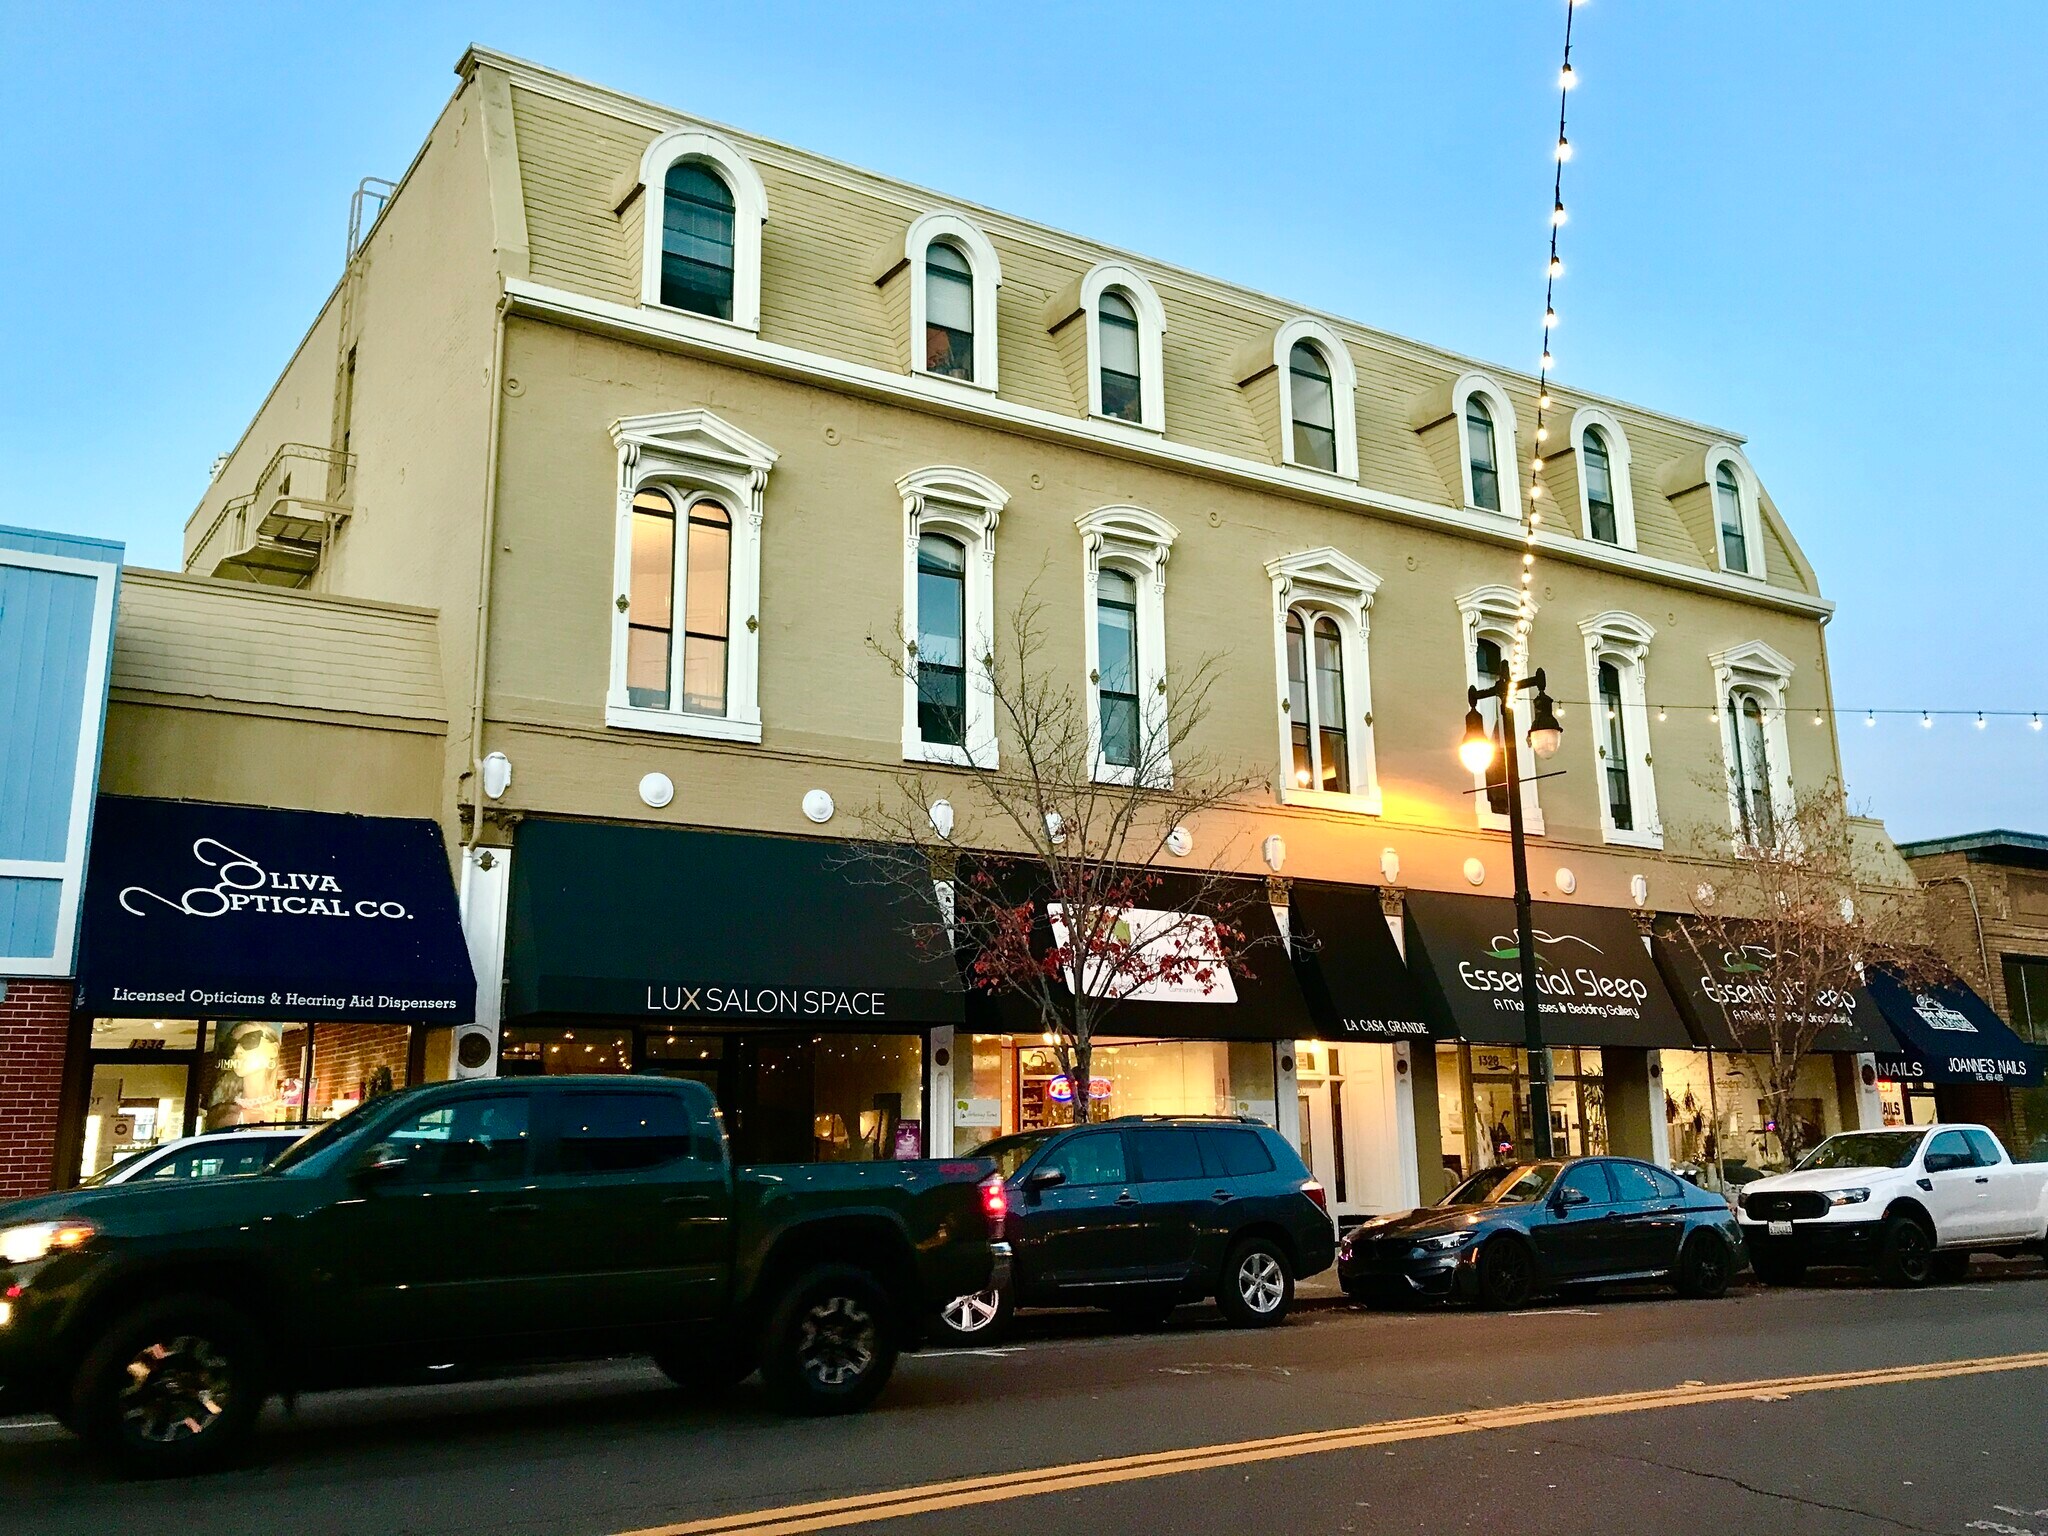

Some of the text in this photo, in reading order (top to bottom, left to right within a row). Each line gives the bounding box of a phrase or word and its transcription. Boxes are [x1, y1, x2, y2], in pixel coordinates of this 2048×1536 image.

[220, 861, 342, 893] OLIVA
[182, 887, 414, 920] OPTICAL CO.
[1575, 967, 1648, 1006] Sleep
[1794, 980, 1856, 1015] Seep
[112, 987, 457, 1012] Licensed Opticians & Hearing Aid Dispensers
[648, 986, 886, 1015] LUX SALON SPACE
[1493, 998, 1504, 1011] A
[1502, 999, 1558, 1014] Matsses
[1568, 1002, 1608, 1018] Bedding
[1606, 1005, 1640, 1019] Gallery
[1343, 1018, 1359, 1031] LA
[1360, 1019, 1386, 1032] CASA
[1387, 1020, 1429, 1034] GRANDE
[1478, 1055, 1500, 1066] 1328
[1877, 1061, 1923, 1077] NAILS
[1948, 1057, 2027, 1075] JOANNE'S NAILS
[1882, 1101, 1901, 1116] AILS
